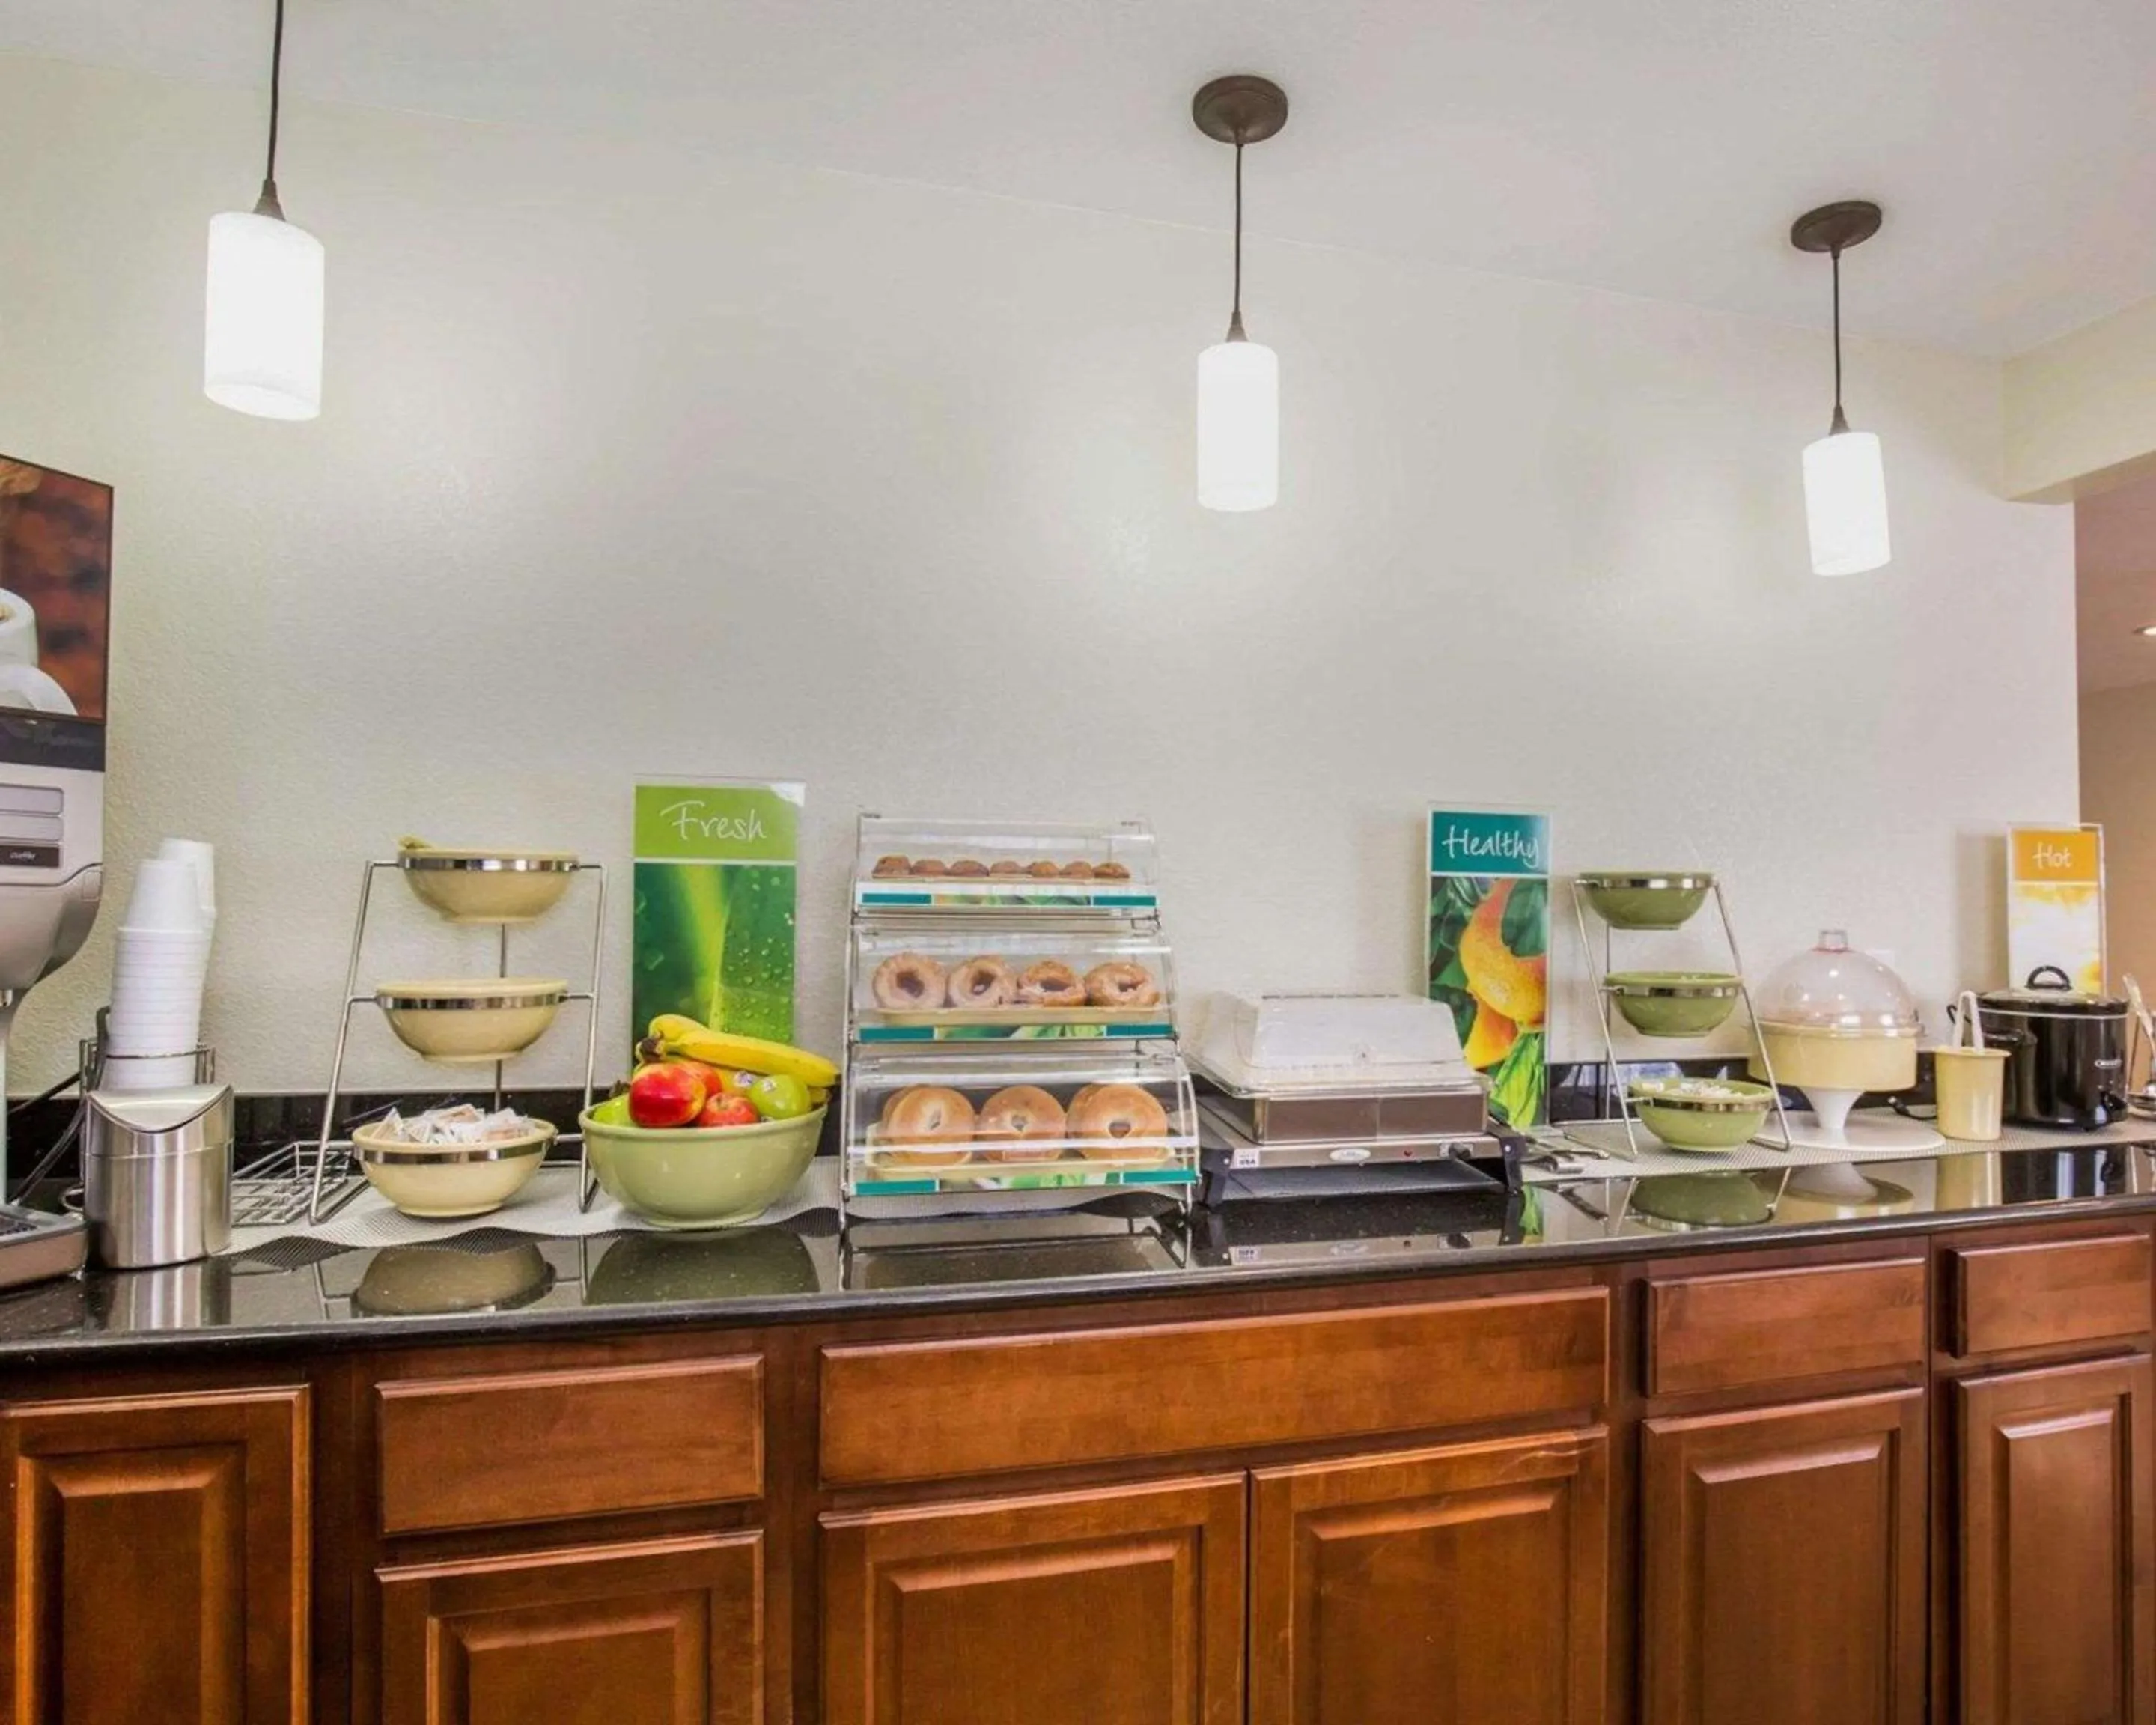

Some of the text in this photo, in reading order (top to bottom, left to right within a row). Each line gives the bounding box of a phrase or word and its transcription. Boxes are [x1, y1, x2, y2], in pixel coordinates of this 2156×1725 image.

[659, 800, 767, 841] Fresh
[1441, 824, 1539, 869] Healthy
[2032, 841, 2072, 869] Hot
